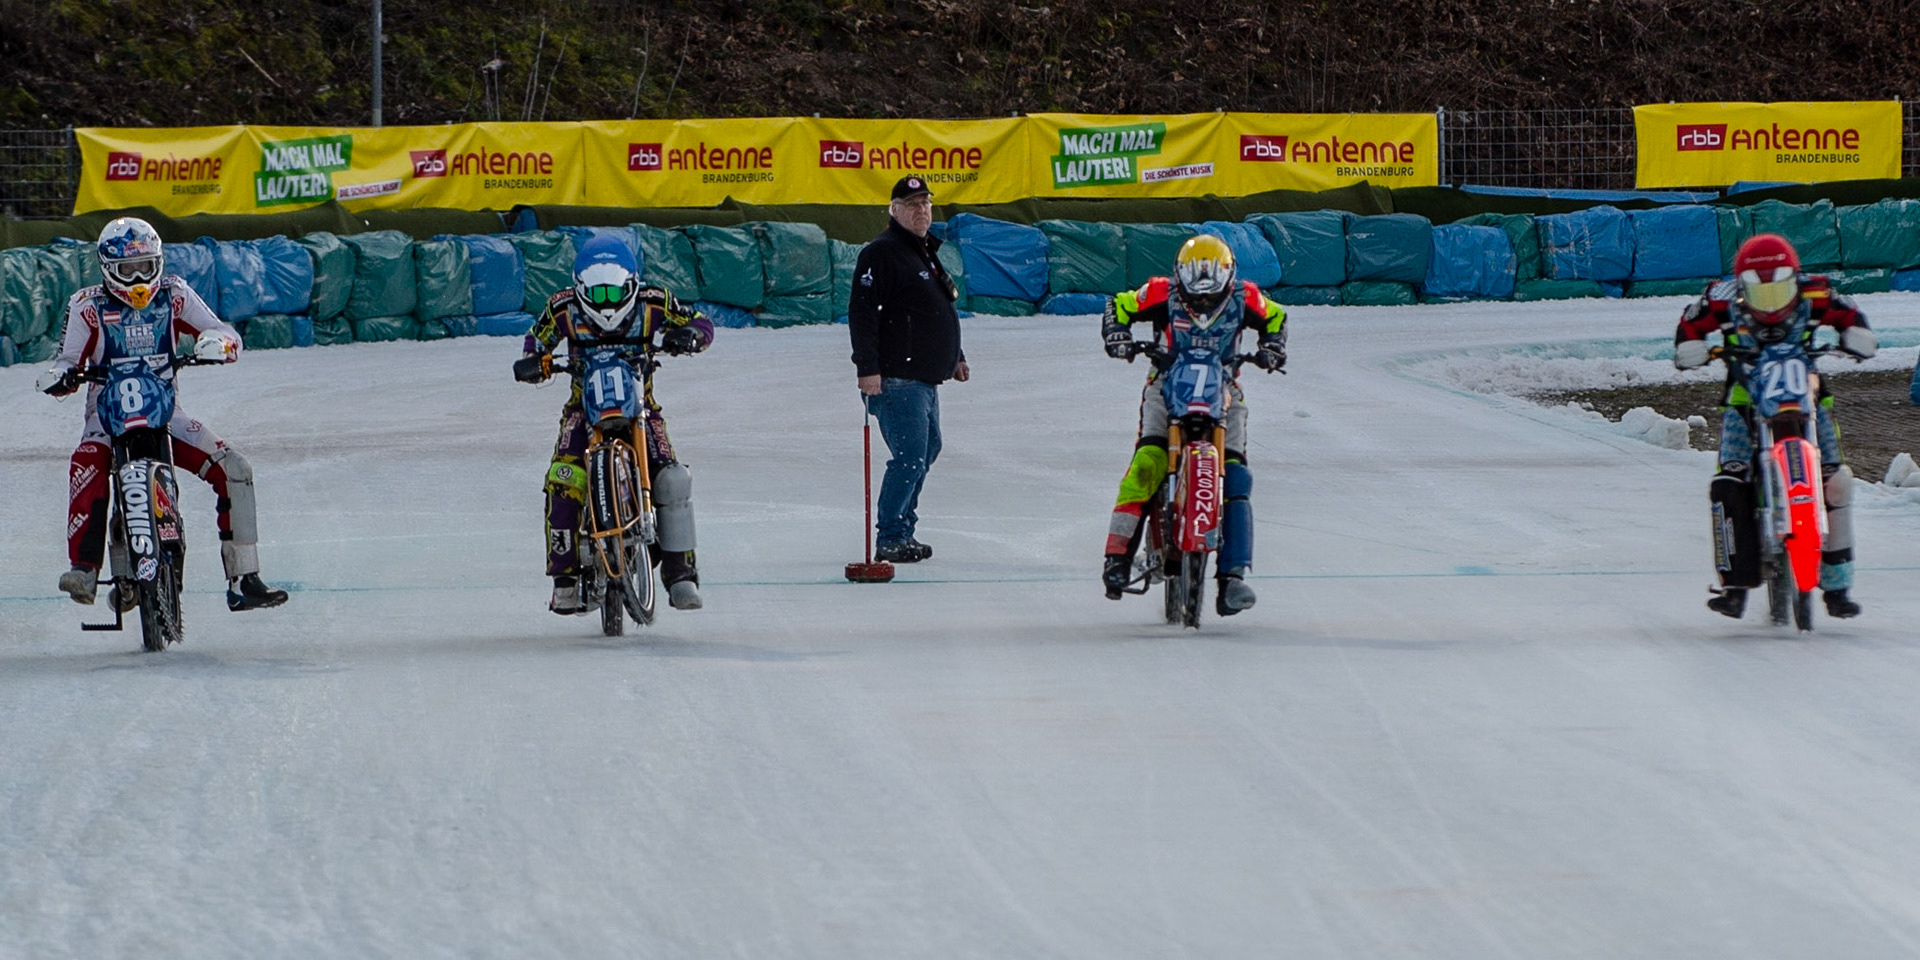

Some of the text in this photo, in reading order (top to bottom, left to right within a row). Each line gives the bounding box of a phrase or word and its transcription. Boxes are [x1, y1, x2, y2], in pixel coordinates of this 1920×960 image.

[1063, 129, 1157, 156] MACH MAL
[1243, 135, 1415, 163] rbb Antenne
[1681, 123, 1860, 150] rbb Antenne
[108, 152, 223, 182] rbb Antenne
[264, 142, 345, 172] MACH MAL
[416, 145, 554, 176] rbb Antenne
[630, 142, 773, 171] rbb Antenne
[823, 141, 983, 170] rbb Antenne
[1055, 157, 1132, 183] LAUTER!
[1776, 154, 1860, 163] BRANDENBURG
[257, 171, 328, 201] LAUTER!
[484, 179, 553, 190] BRANDENBURG
[702, 172, 774, 184] BRANDENBURG
[1145, 172, 1156, 180] DIE
[1190, 165, 1212, 175] MUSIK
[1336, 167, 1415, 177] BRANDENBURG
[588, 366, 626, 405] 11
[1189, 363, 1209, 398] 7
[1762, 358, 1808, 399] 20
[119, 377, 144, 414] 8
